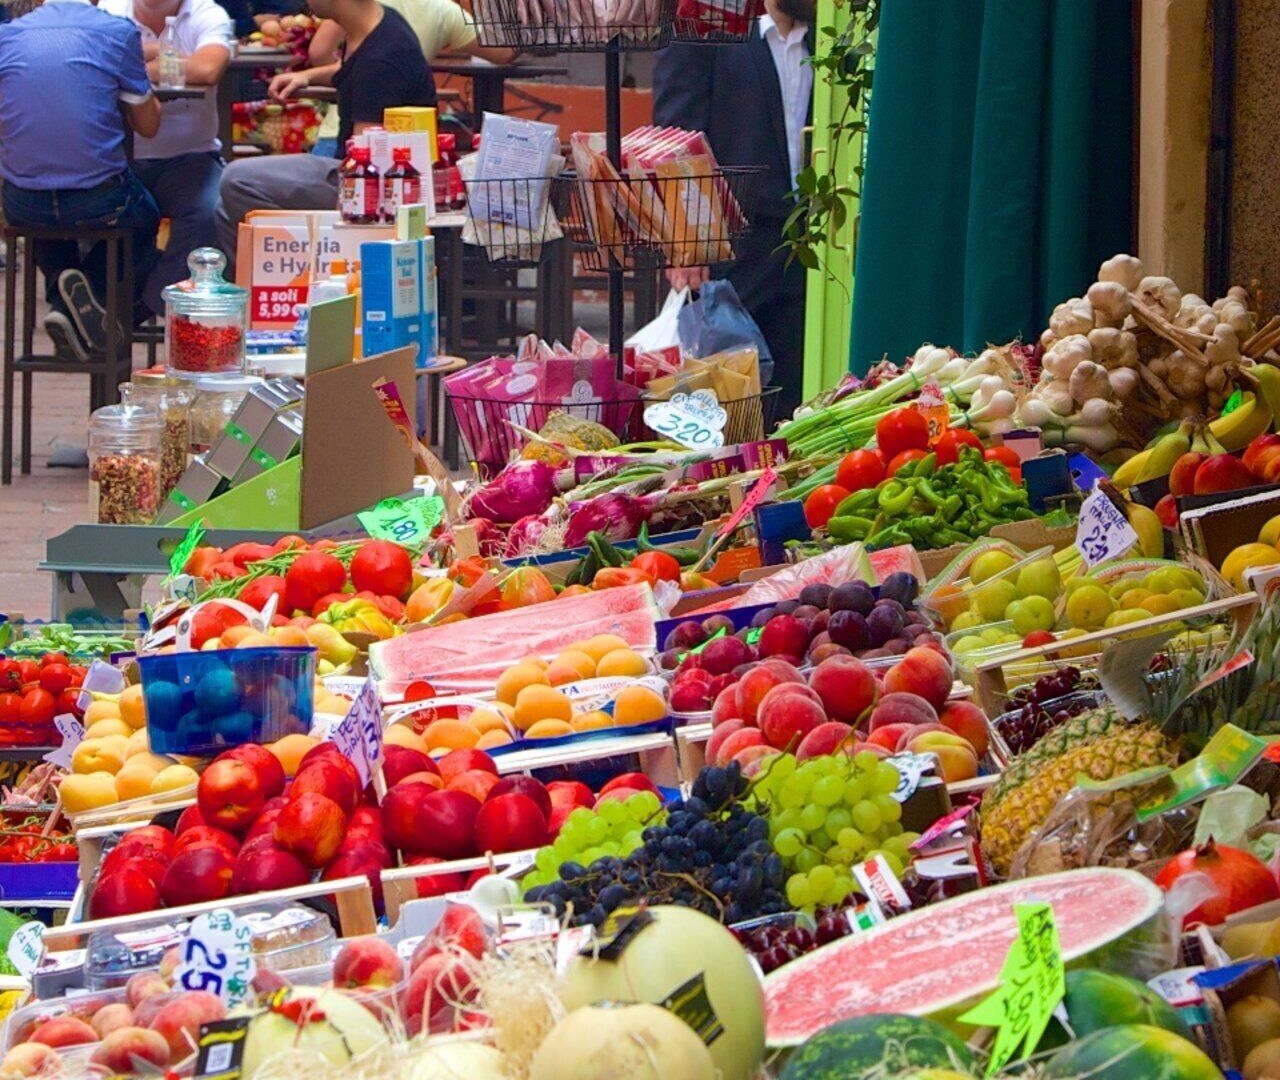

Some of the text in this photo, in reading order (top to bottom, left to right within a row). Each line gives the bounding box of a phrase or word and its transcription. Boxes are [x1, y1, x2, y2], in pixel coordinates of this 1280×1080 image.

[262, 261, 274, 274] e
[258, 288, 298, 302] a soli
